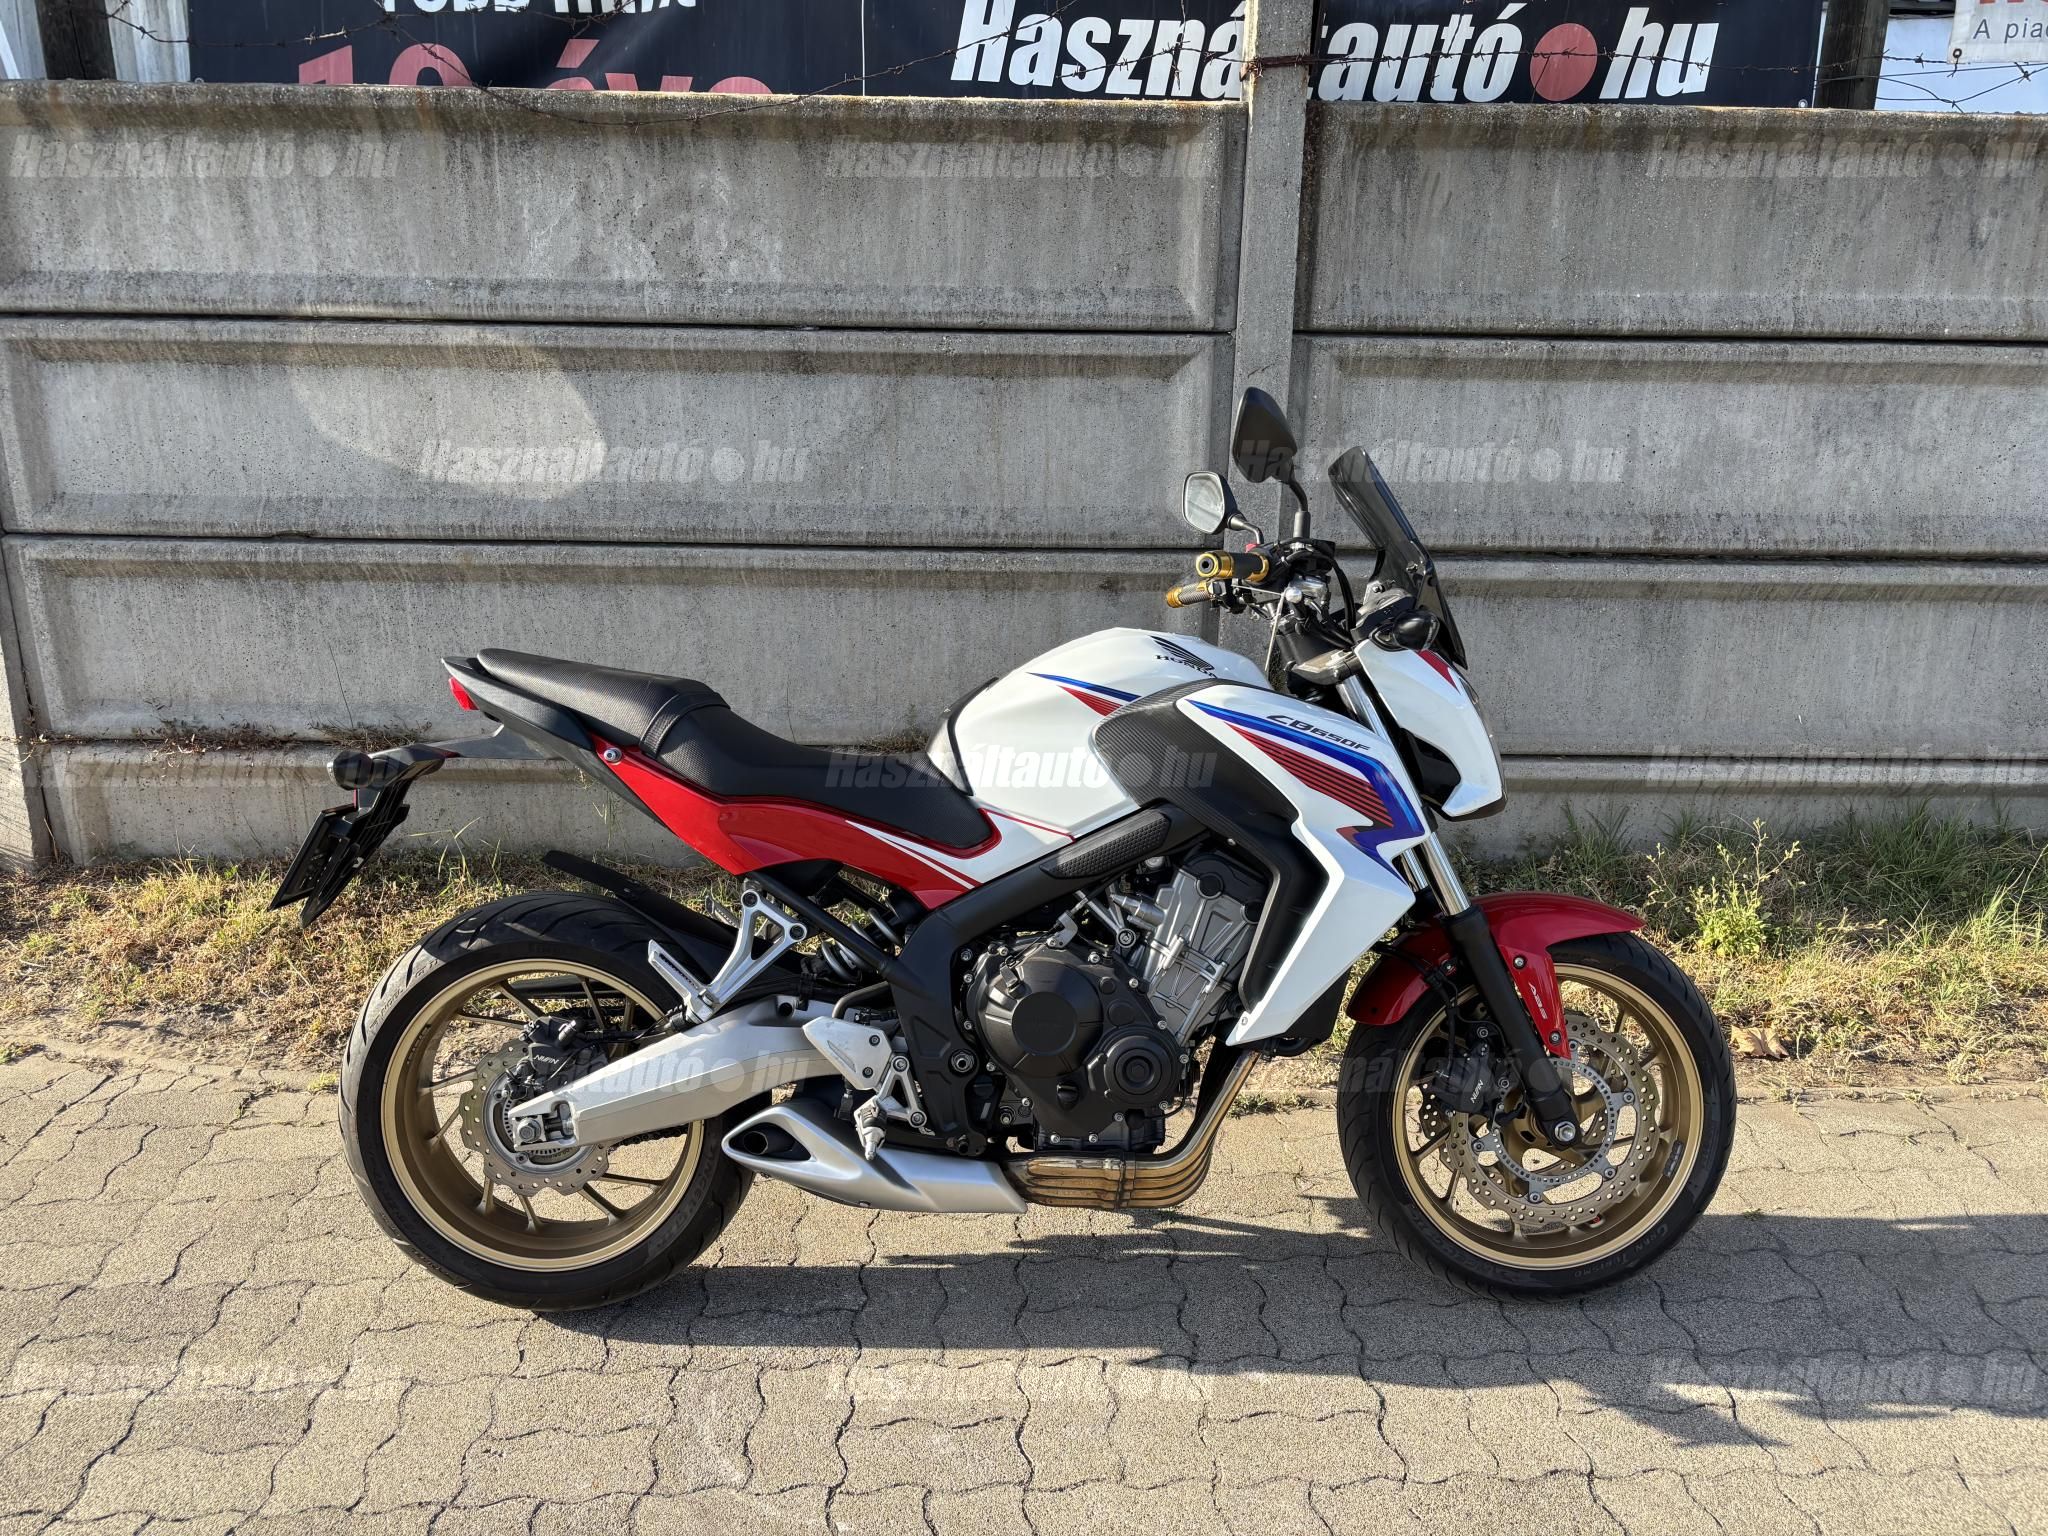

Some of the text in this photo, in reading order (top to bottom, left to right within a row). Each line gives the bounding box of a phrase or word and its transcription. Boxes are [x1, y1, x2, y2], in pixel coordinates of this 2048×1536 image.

[1973, 17, 2048, 44] A pia
[1266, 714, 1371, 751] CB650F
